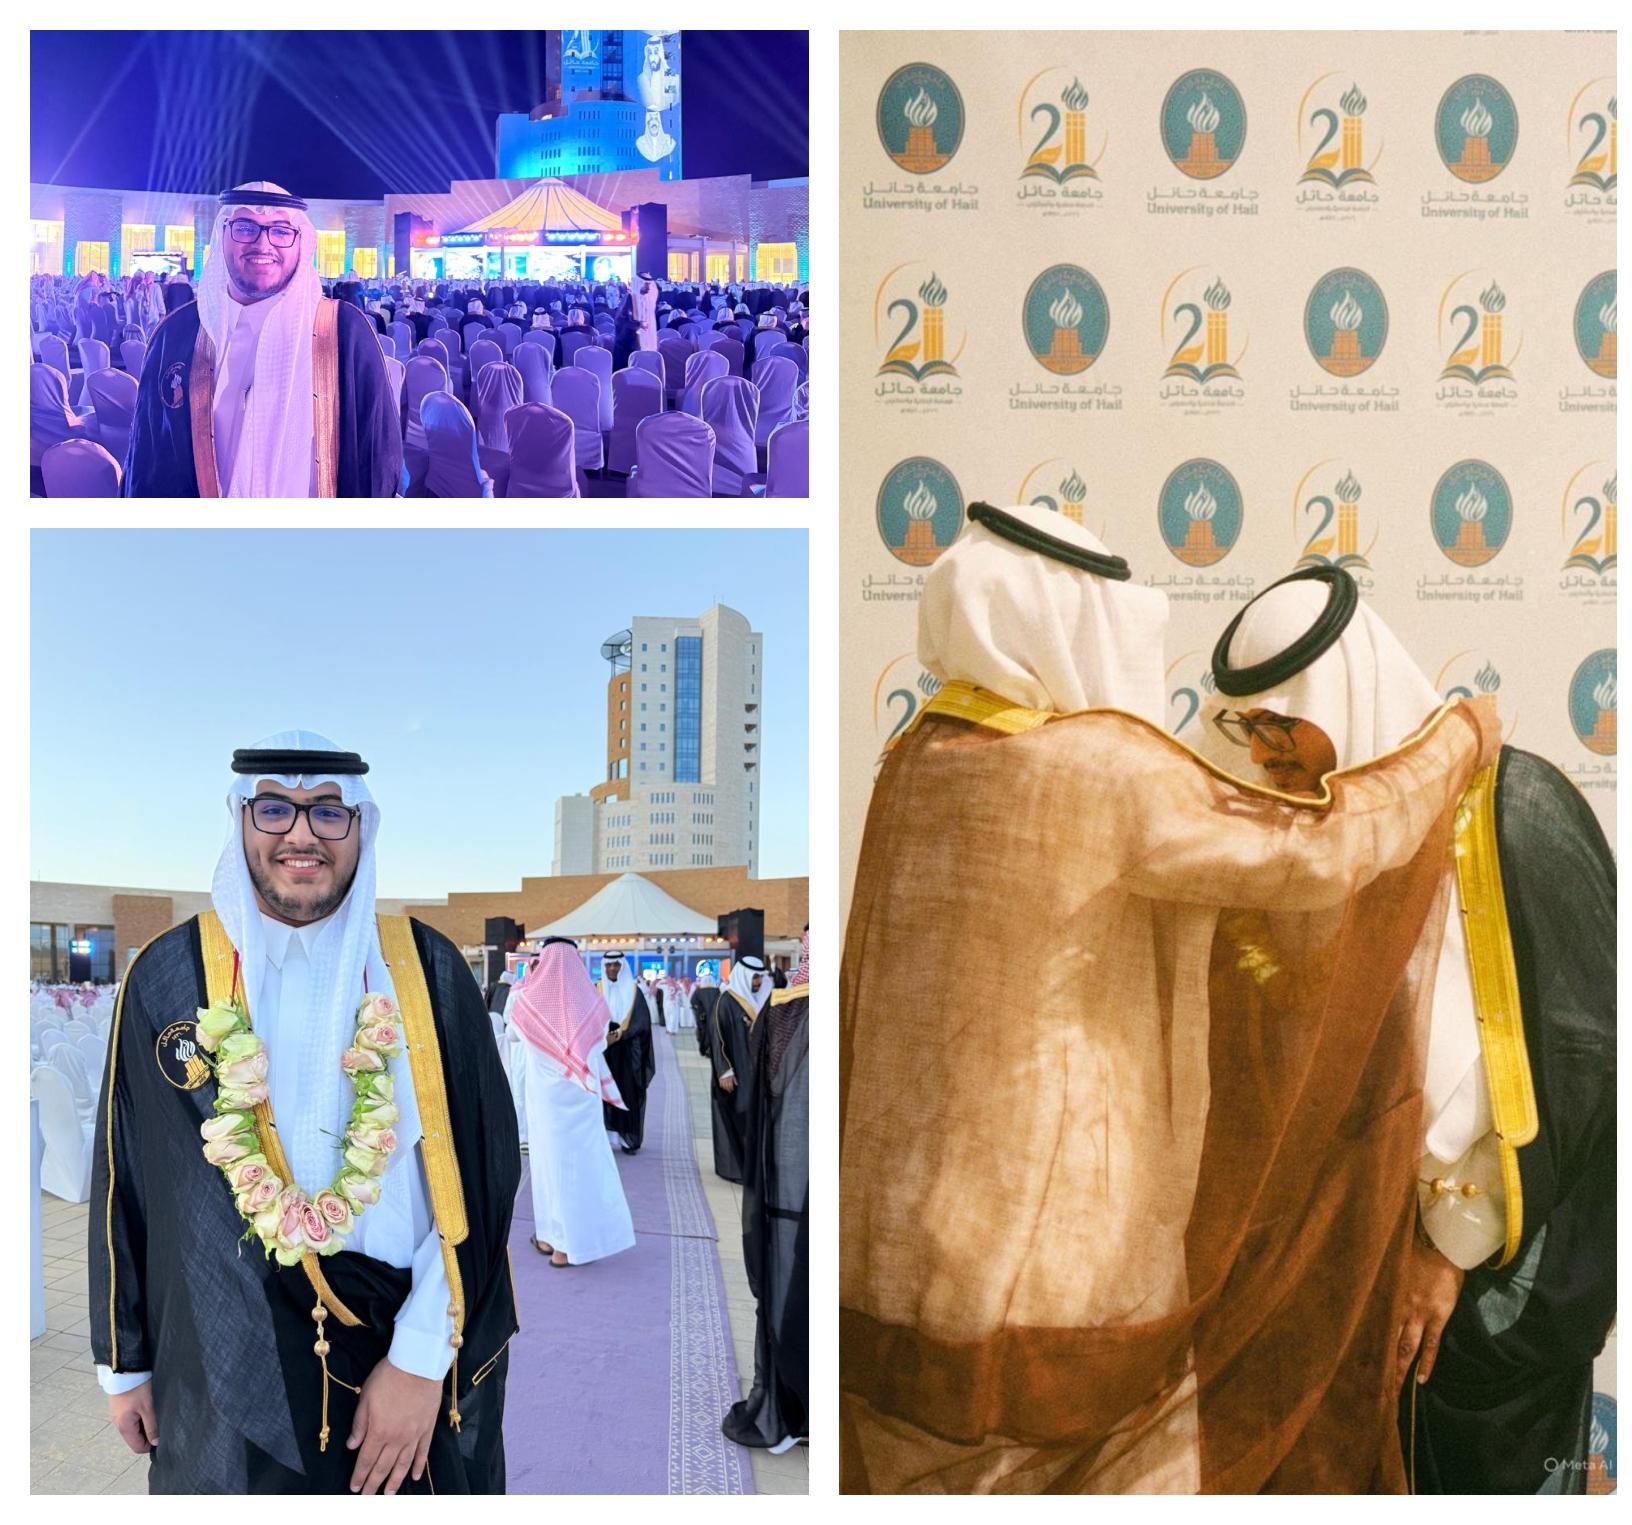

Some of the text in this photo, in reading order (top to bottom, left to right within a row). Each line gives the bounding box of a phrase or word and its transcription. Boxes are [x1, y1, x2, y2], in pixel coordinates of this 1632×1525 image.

[863, 197, 932, 212] University
[934, 198, 947, 210] of
[1147, 202, 1214, 217] University
[1217, 203, 1230, 215] of
[1421, 206, 1486, 221] University
[1488, 206, 1500, 218] of
[1009, 398, 1077, 413] University
[1079, 398, 1092, 410] of
[1290, 400, 1356, 414] University
[1358, 400, 1370, 411] of
[1558, 401, 1617, 412] Universit
[862, 589, 922, 601] Universi
[1167, 589, 1211, 603] versity
[1213, 590, 1226, 601] of
[1416, 589, 1481, 603] University
[1483, 590, 1496, 601] of
